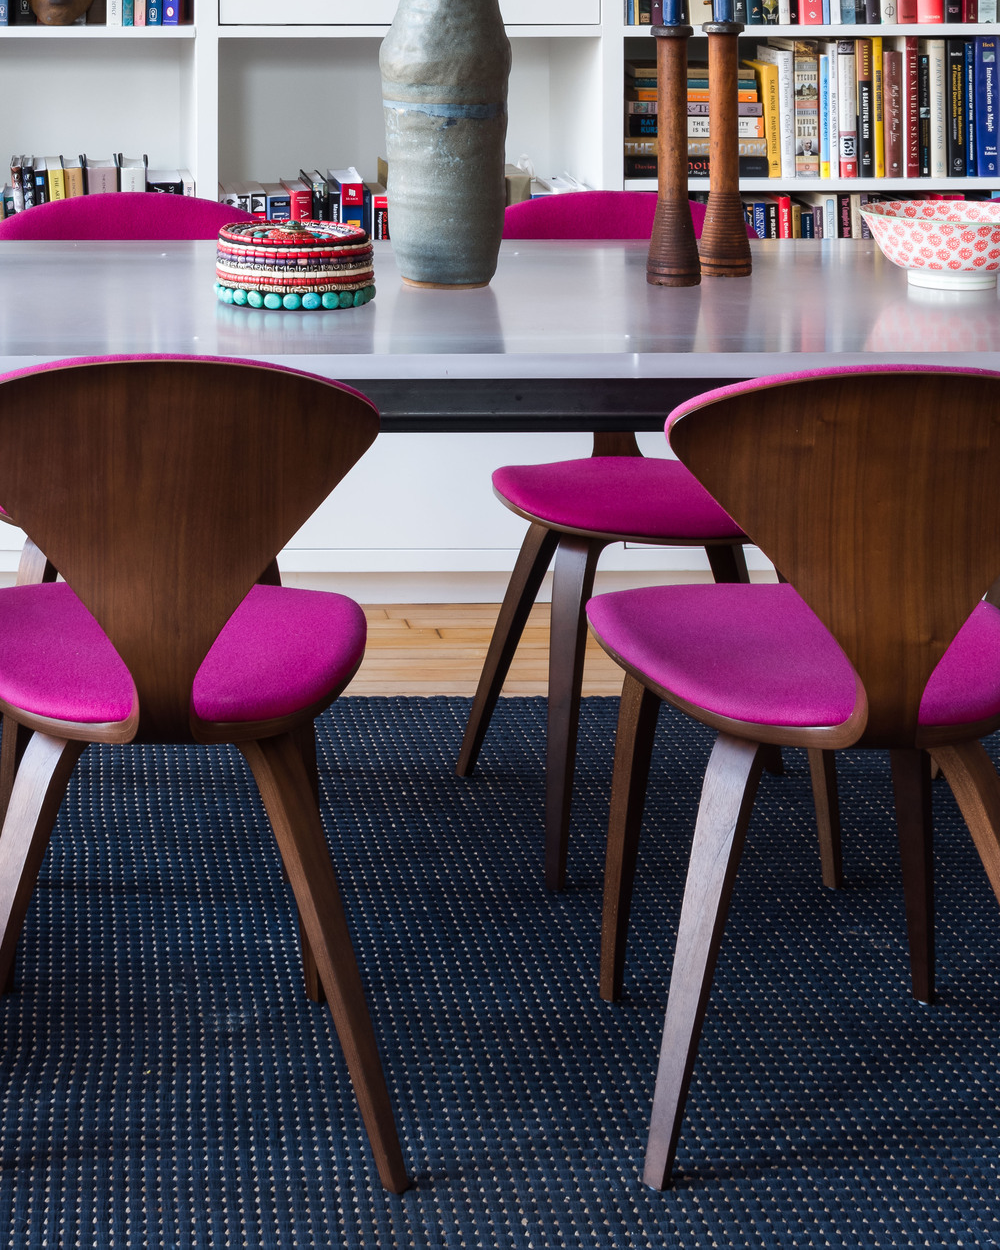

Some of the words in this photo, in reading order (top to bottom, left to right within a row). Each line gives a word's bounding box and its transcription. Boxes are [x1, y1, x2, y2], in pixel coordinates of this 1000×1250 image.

[935, 57, 943, 87] JOURNEY
[986, 67, 994, 104] Introduction
[986, 113, 995, 132] Maple
[910, 132, 918, 159] SENSE
[936, 125, 944, 150] GENIUS
